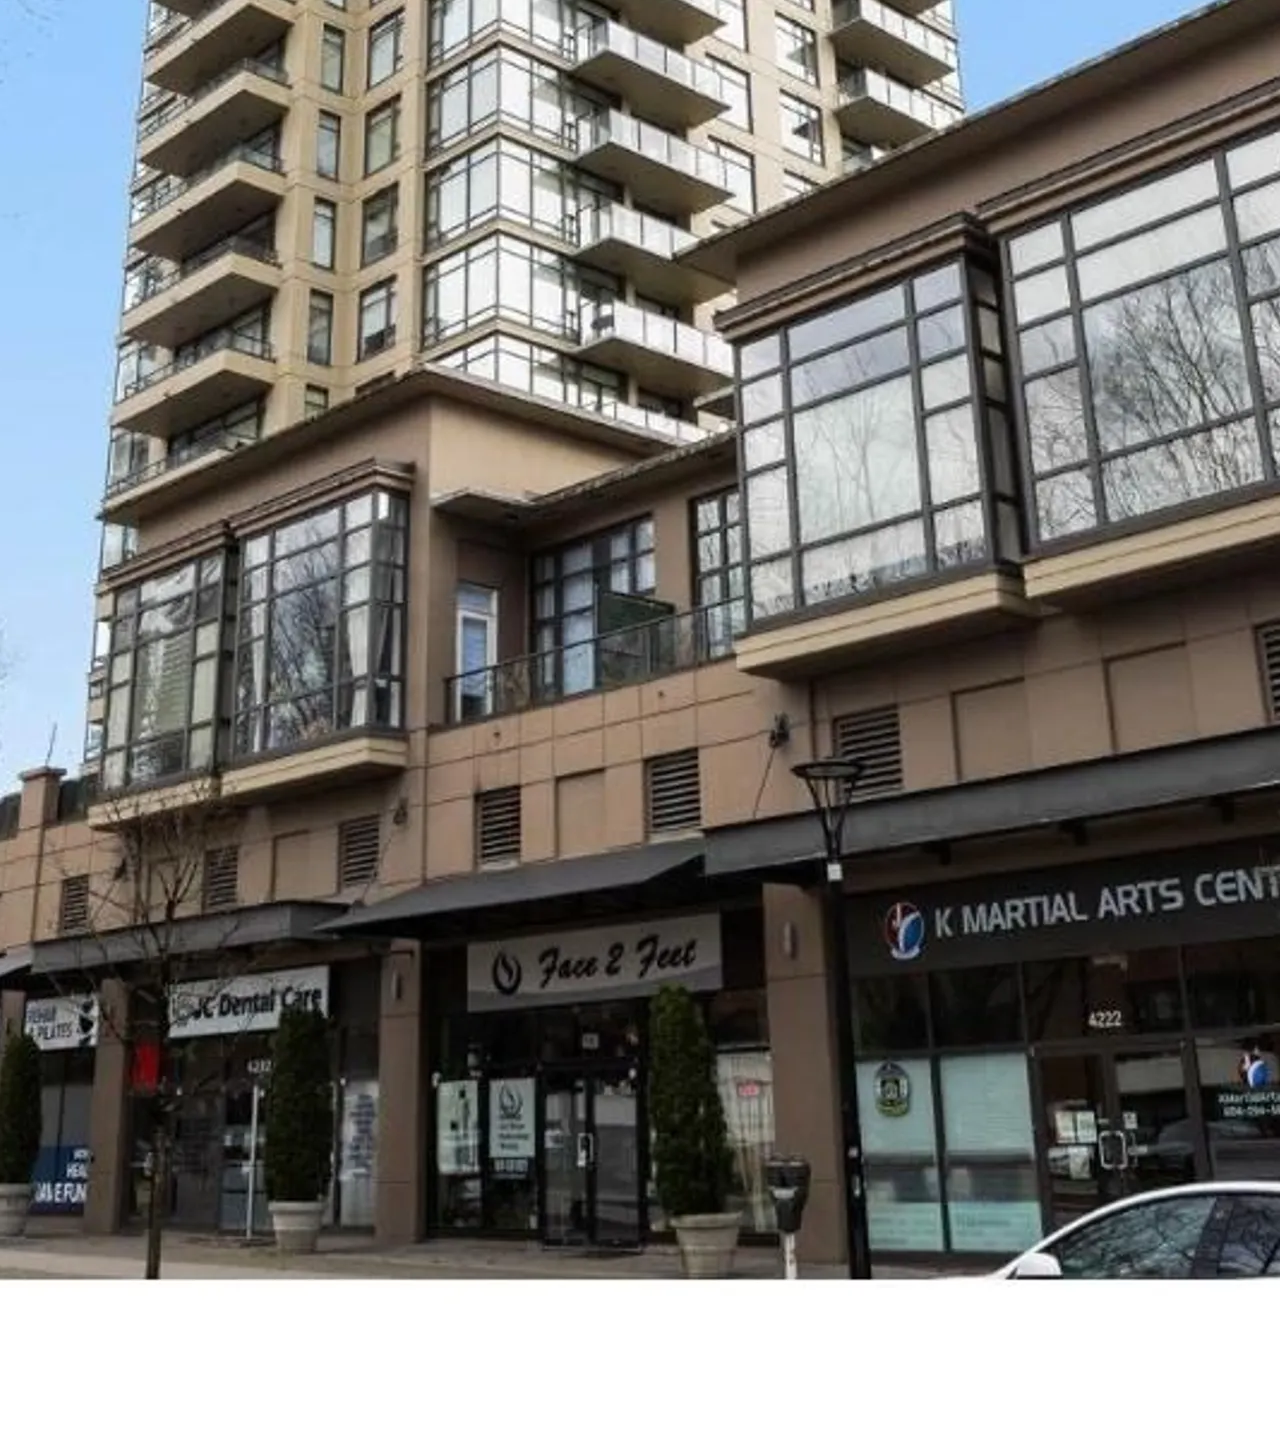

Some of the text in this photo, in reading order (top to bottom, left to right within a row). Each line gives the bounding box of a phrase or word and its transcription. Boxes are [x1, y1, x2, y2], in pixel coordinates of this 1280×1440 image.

[935, 907, 953, 938] K
[961, 891, 1088, 936] MARTIAL
[1097, 877, 1185, 919] ARTS
[538, 933, 698, 989] Face 2 Feet
[219, 988, 276, 1017] Dental
[281, 985, 323, 1010] Care
